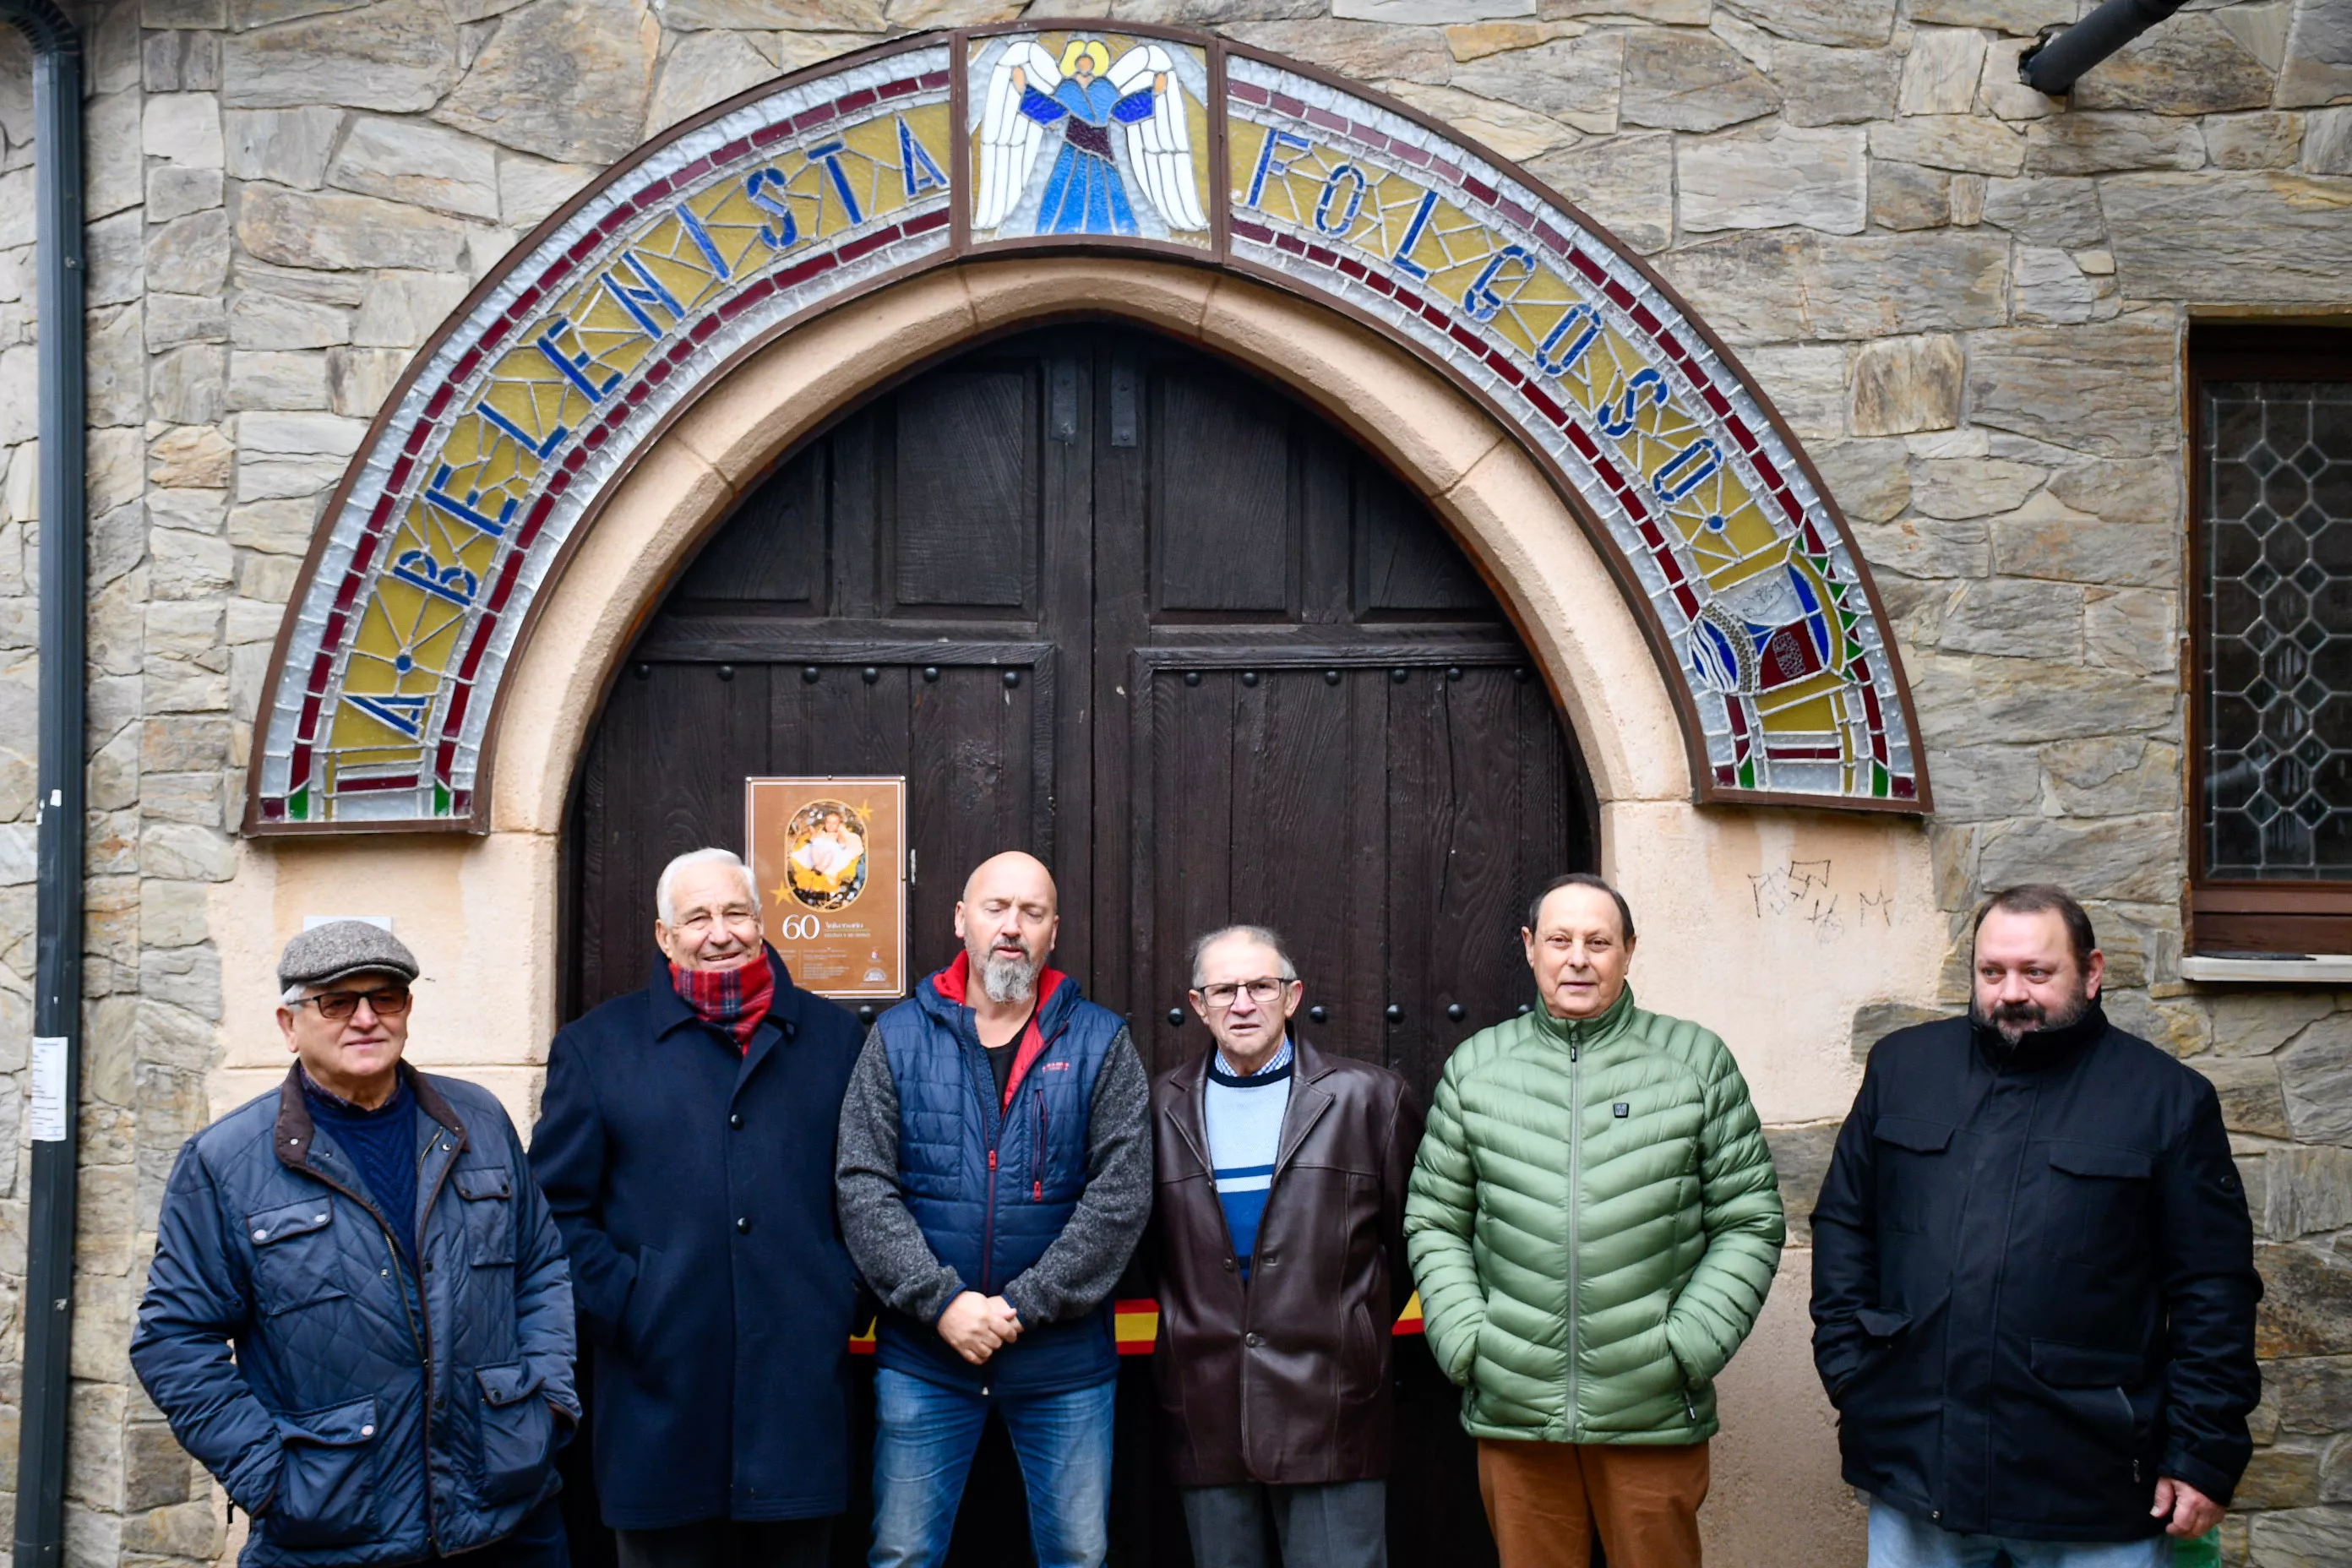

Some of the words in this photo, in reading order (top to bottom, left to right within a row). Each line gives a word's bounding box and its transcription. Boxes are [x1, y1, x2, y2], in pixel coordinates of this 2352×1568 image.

[392, 112, 949, 607] BELENISTA
[1248, 127, 1723, 504] FOLGOSO
[781, 913, 821, 940] 60
